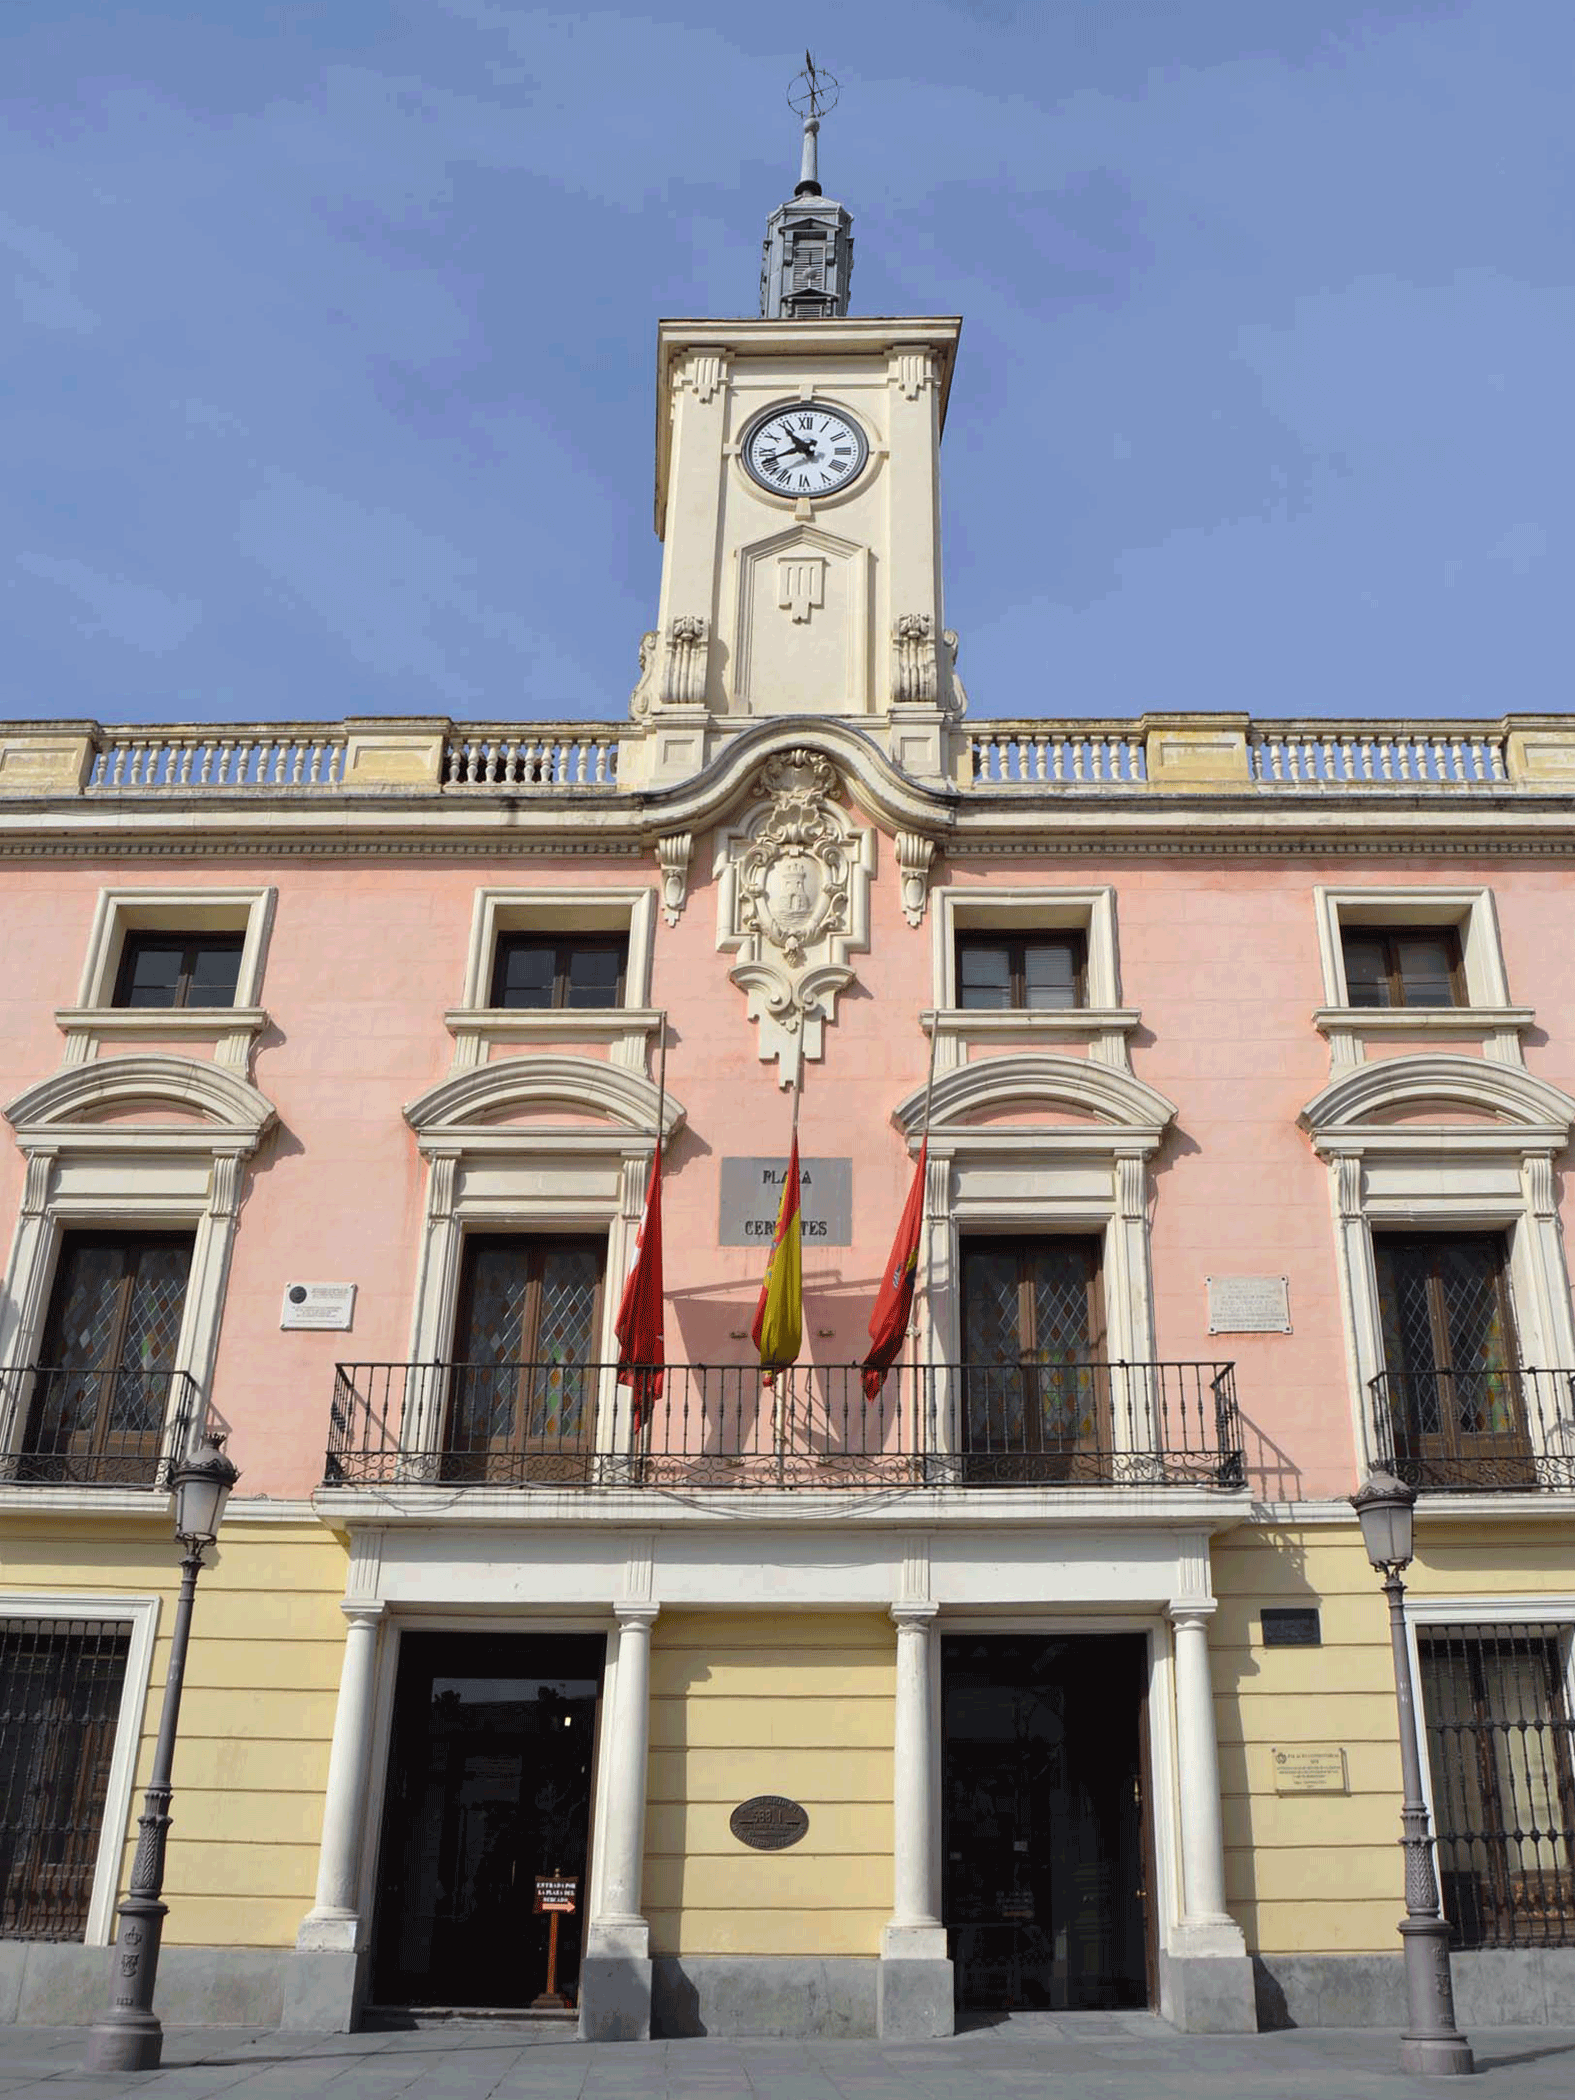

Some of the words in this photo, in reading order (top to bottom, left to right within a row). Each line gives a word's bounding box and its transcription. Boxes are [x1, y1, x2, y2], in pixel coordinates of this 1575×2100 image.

[798, 417, 813, 430] XII
[764, 432, 781, 443] X
[830, 431, 846, 442] II
[759, 447, 776, 456] IX
[834, 447, 851, 455] III
[776, 469, 792, 485] VII
[799, 474, 810, 487] VI
[820, 472, 831, 483] V
[763, 1170, 812, 1184] PLAA
[745, 1221, 828, 1236] CERTES
